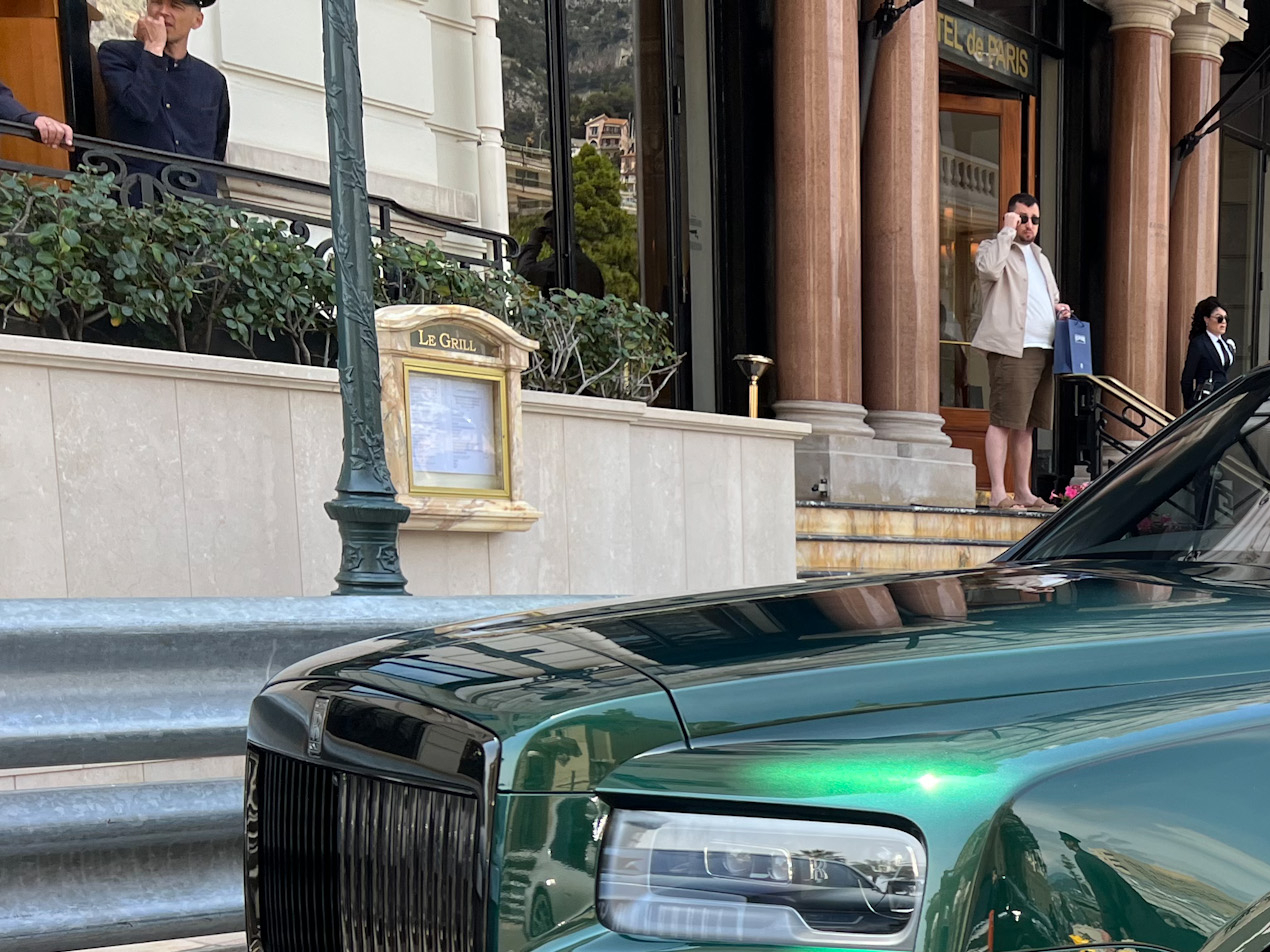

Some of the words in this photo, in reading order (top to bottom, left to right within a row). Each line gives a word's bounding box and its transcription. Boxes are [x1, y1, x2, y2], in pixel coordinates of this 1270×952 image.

[966, 26, 984, 59] de
[988, 34, 1029, 79] PARIS
[439, 333, 477, 352] GRILL
